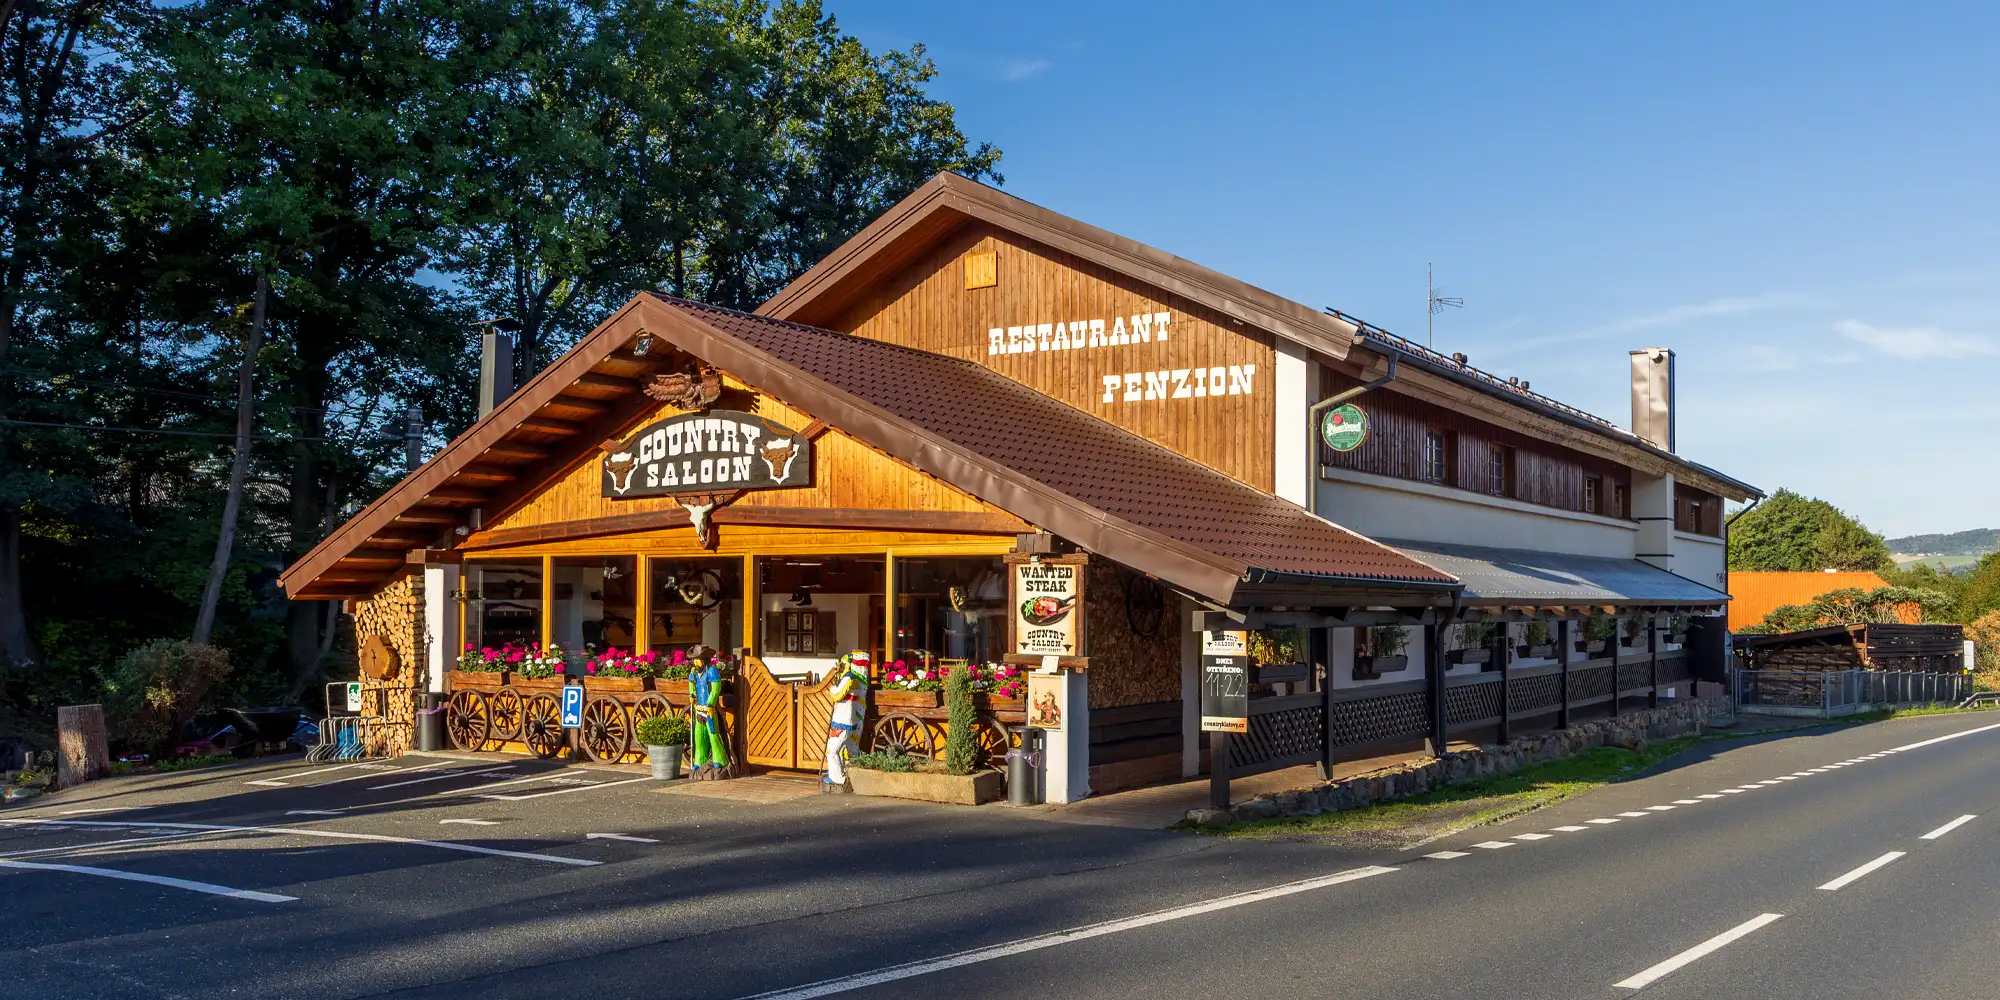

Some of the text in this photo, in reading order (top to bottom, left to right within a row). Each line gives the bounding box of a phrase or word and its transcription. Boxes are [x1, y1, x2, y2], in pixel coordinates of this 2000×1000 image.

[988, 312, 1171, 356] RESTAURANT
[1102, 364, 1255, 404] PENZION
[639, 418, 761, 465] COUNTRY
[646, 456, 752, 488] SALOON
[1020, 566, 1073, 579] WANTED
[1025, 580, 1067, 593] STEAK
[1027, 629, 1066, 641] COUNTRY
[1031, 639, 1061, 647] SALOON
[1206, 673, 1245, 698] 11-22
[567, 690, 578, 712] P
[1203, 721, 1245, 730] countryklatovy.cz
